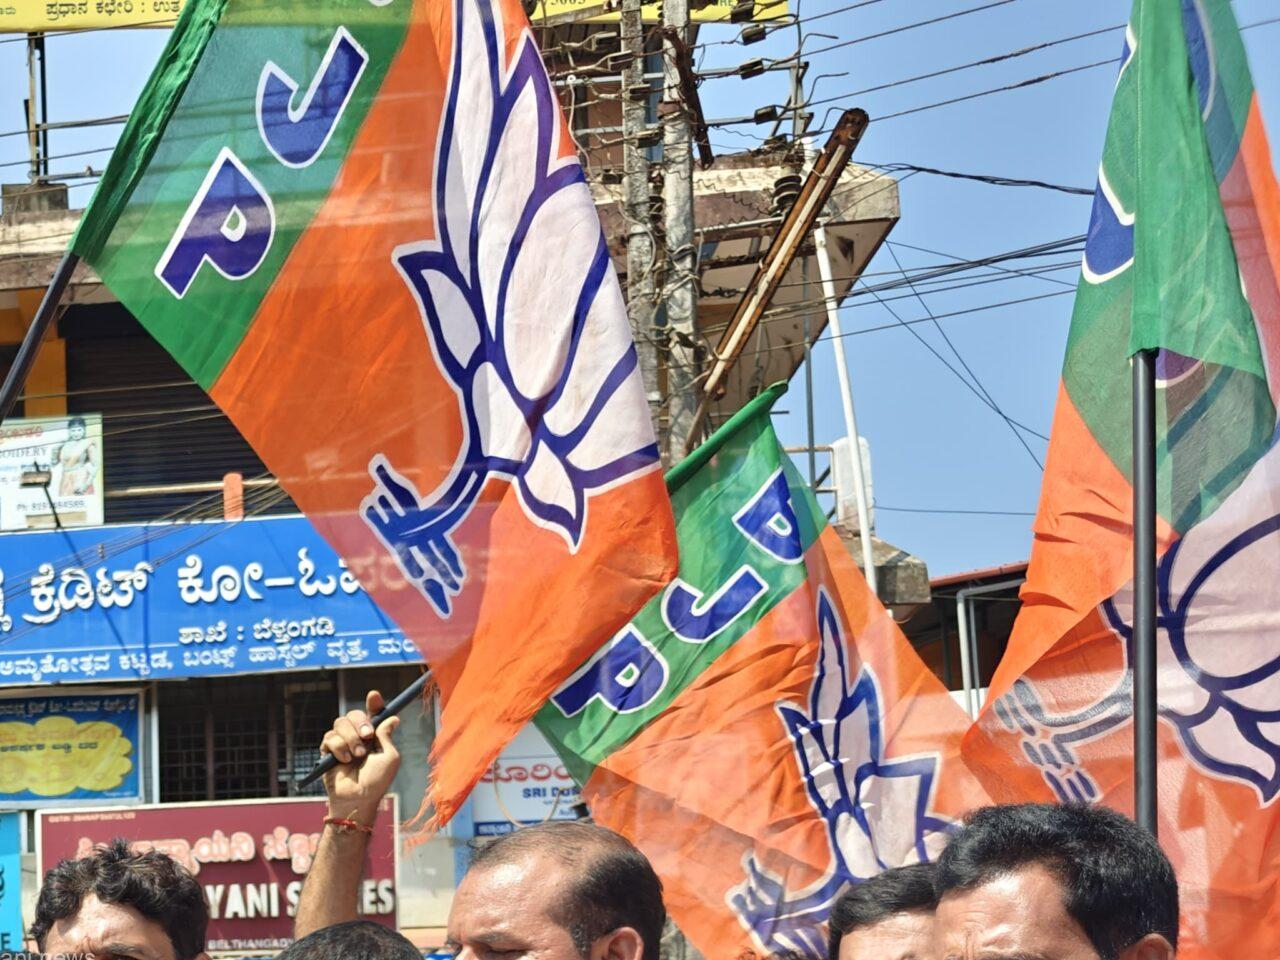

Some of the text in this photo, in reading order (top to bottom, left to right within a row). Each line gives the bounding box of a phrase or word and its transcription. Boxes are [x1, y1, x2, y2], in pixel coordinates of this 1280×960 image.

[21, 560, 154, 625] ಕ್ರೆಡಿಟ್
[177, 621, 228, 645] ಶಾಖೆ
[522, 786, 547, 799] SRI
